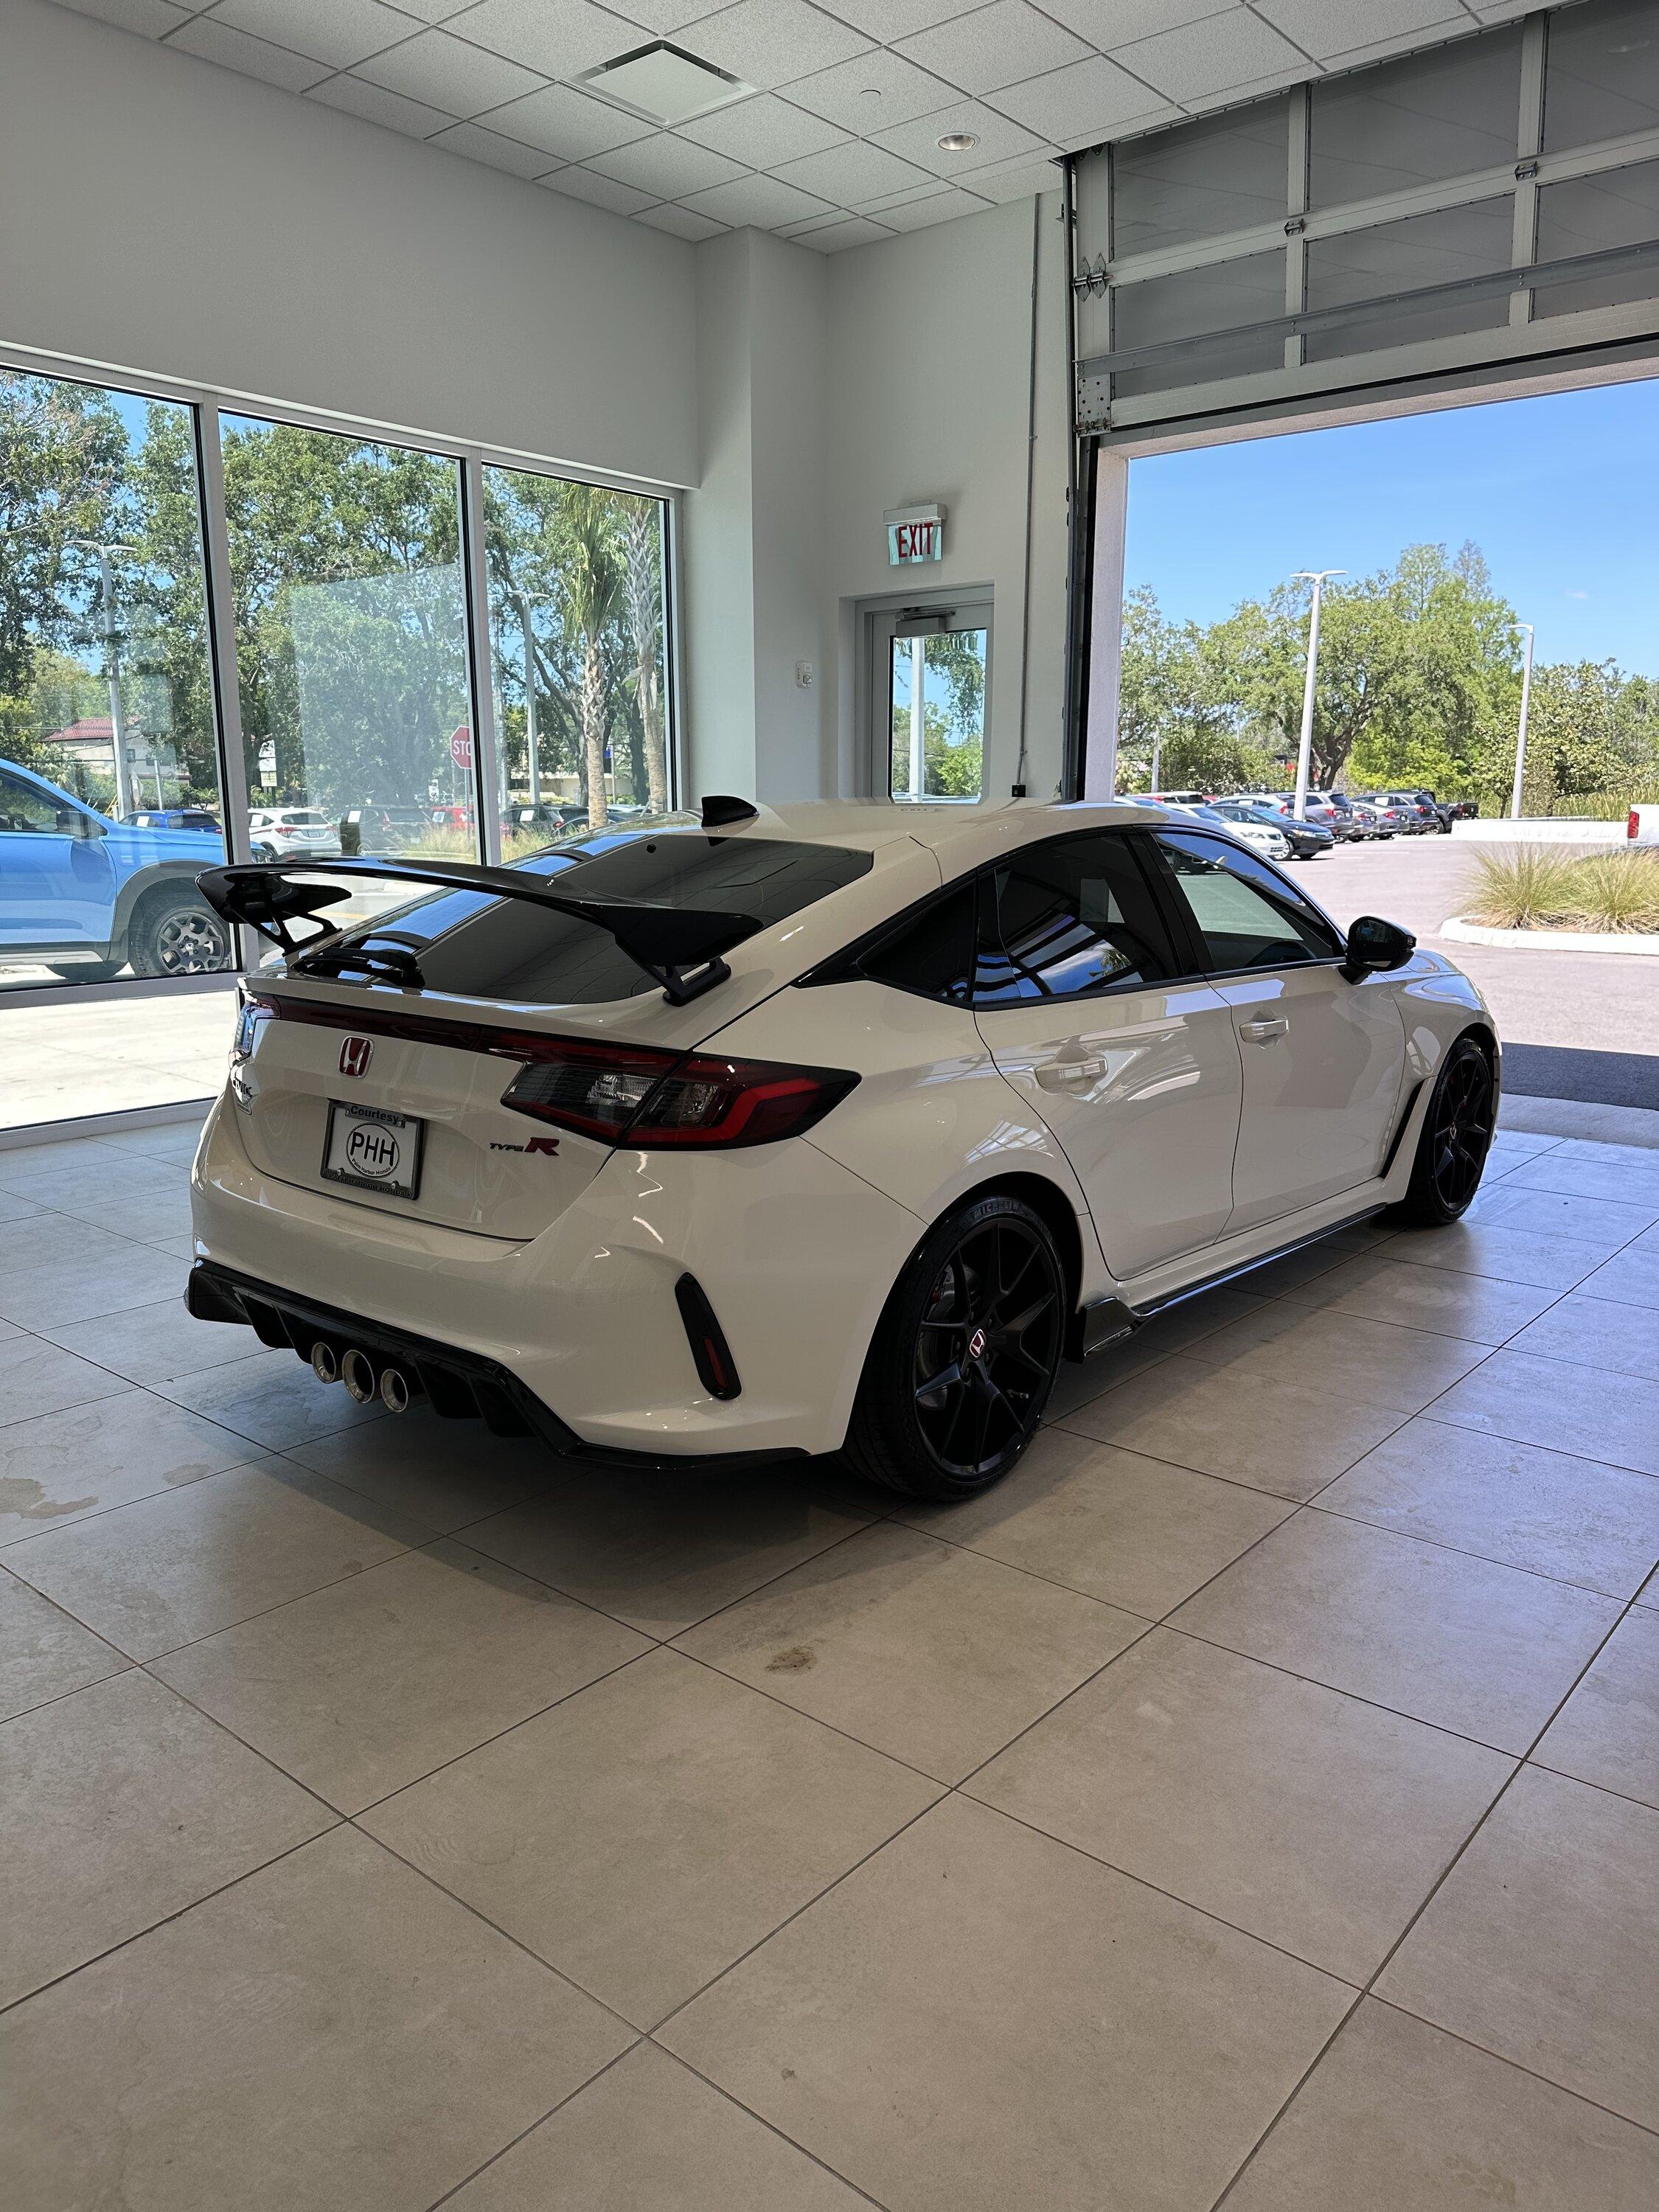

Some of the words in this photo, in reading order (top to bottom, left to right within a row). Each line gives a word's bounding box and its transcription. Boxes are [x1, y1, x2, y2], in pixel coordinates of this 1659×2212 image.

[898, 522, 933, 557] EXIT
[453, 740, 471, 756] STO
[351, 1105, 399, 1125] Courtesy
[349, 1131, 395, 1166] PHH
[489, 1142, 524, 1152] TYPE
[524, 1137, 560, 1156] R
